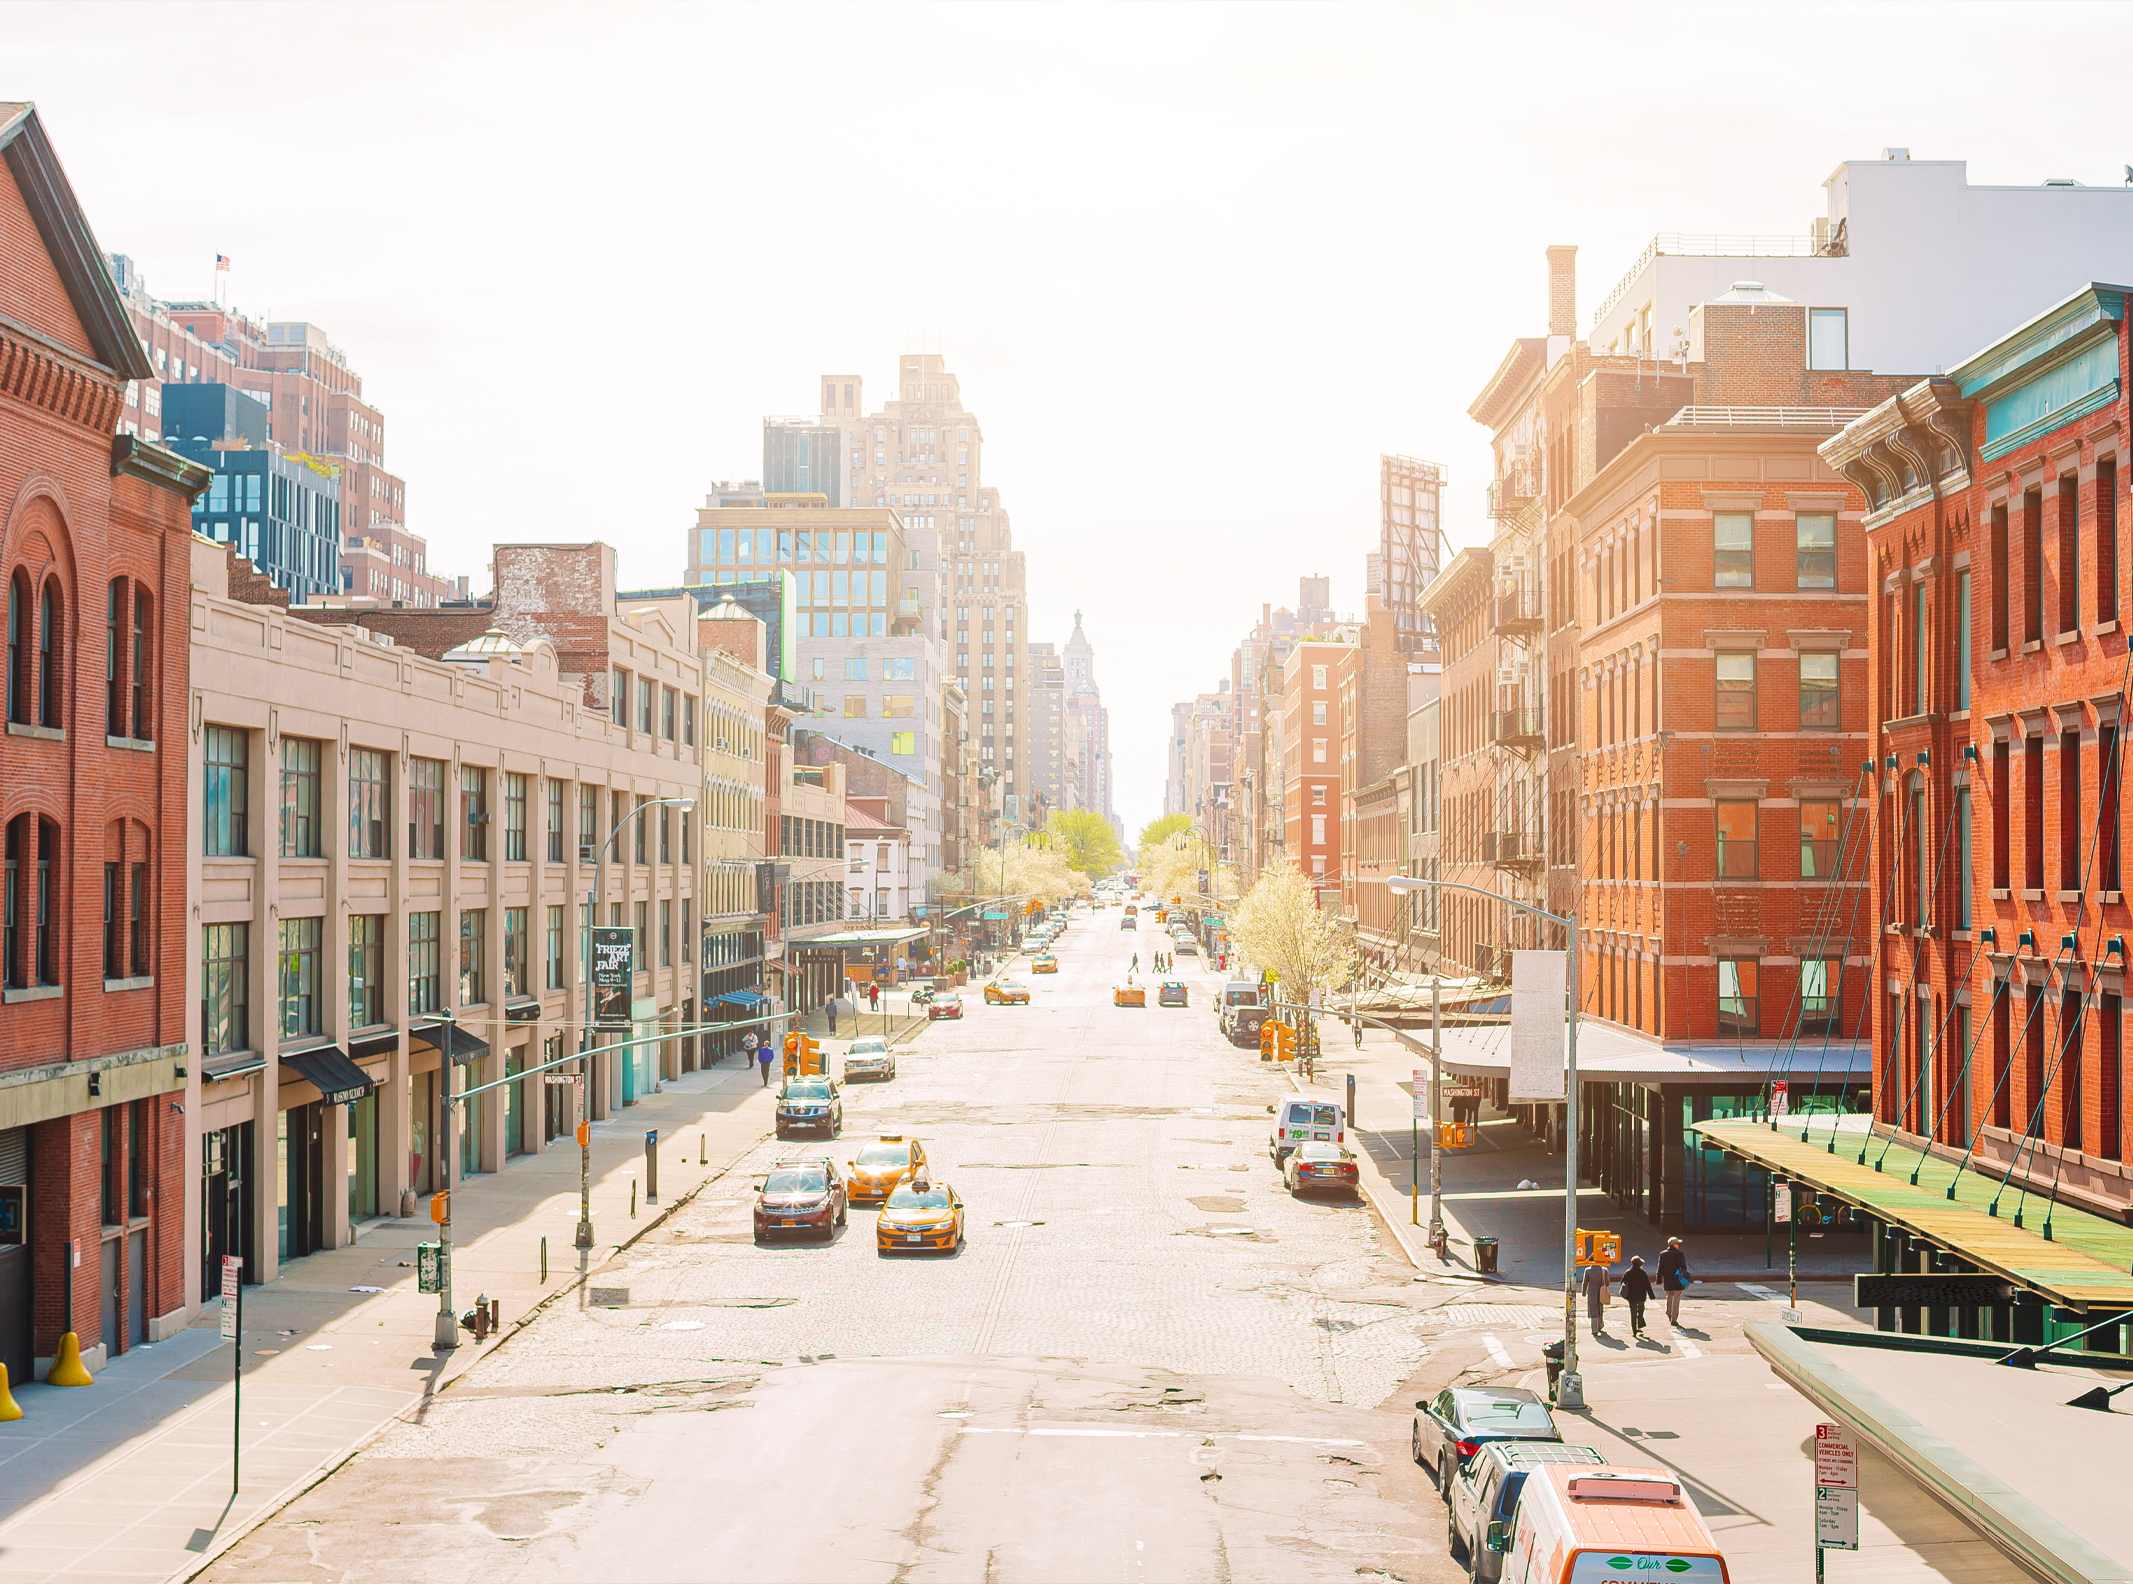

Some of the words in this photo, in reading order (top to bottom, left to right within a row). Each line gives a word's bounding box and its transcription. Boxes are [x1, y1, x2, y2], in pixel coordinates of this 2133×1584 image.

[596, 945, 629, 954] FRIEZE
[609, 953, 628, 962] ART
[596, 961, 619, 970] FAIR
[545, 1075, 575, 1084] WASHINGTON
[575, 1075, 582, 1084] ST
[1444, 1088, 1472, 1097] WASHINGTON
[1819, 1427, 1825, 1438] 3
[1819, 1488, 1825, 1500] 2
[1637, 1557, 1661, 1570] Our
